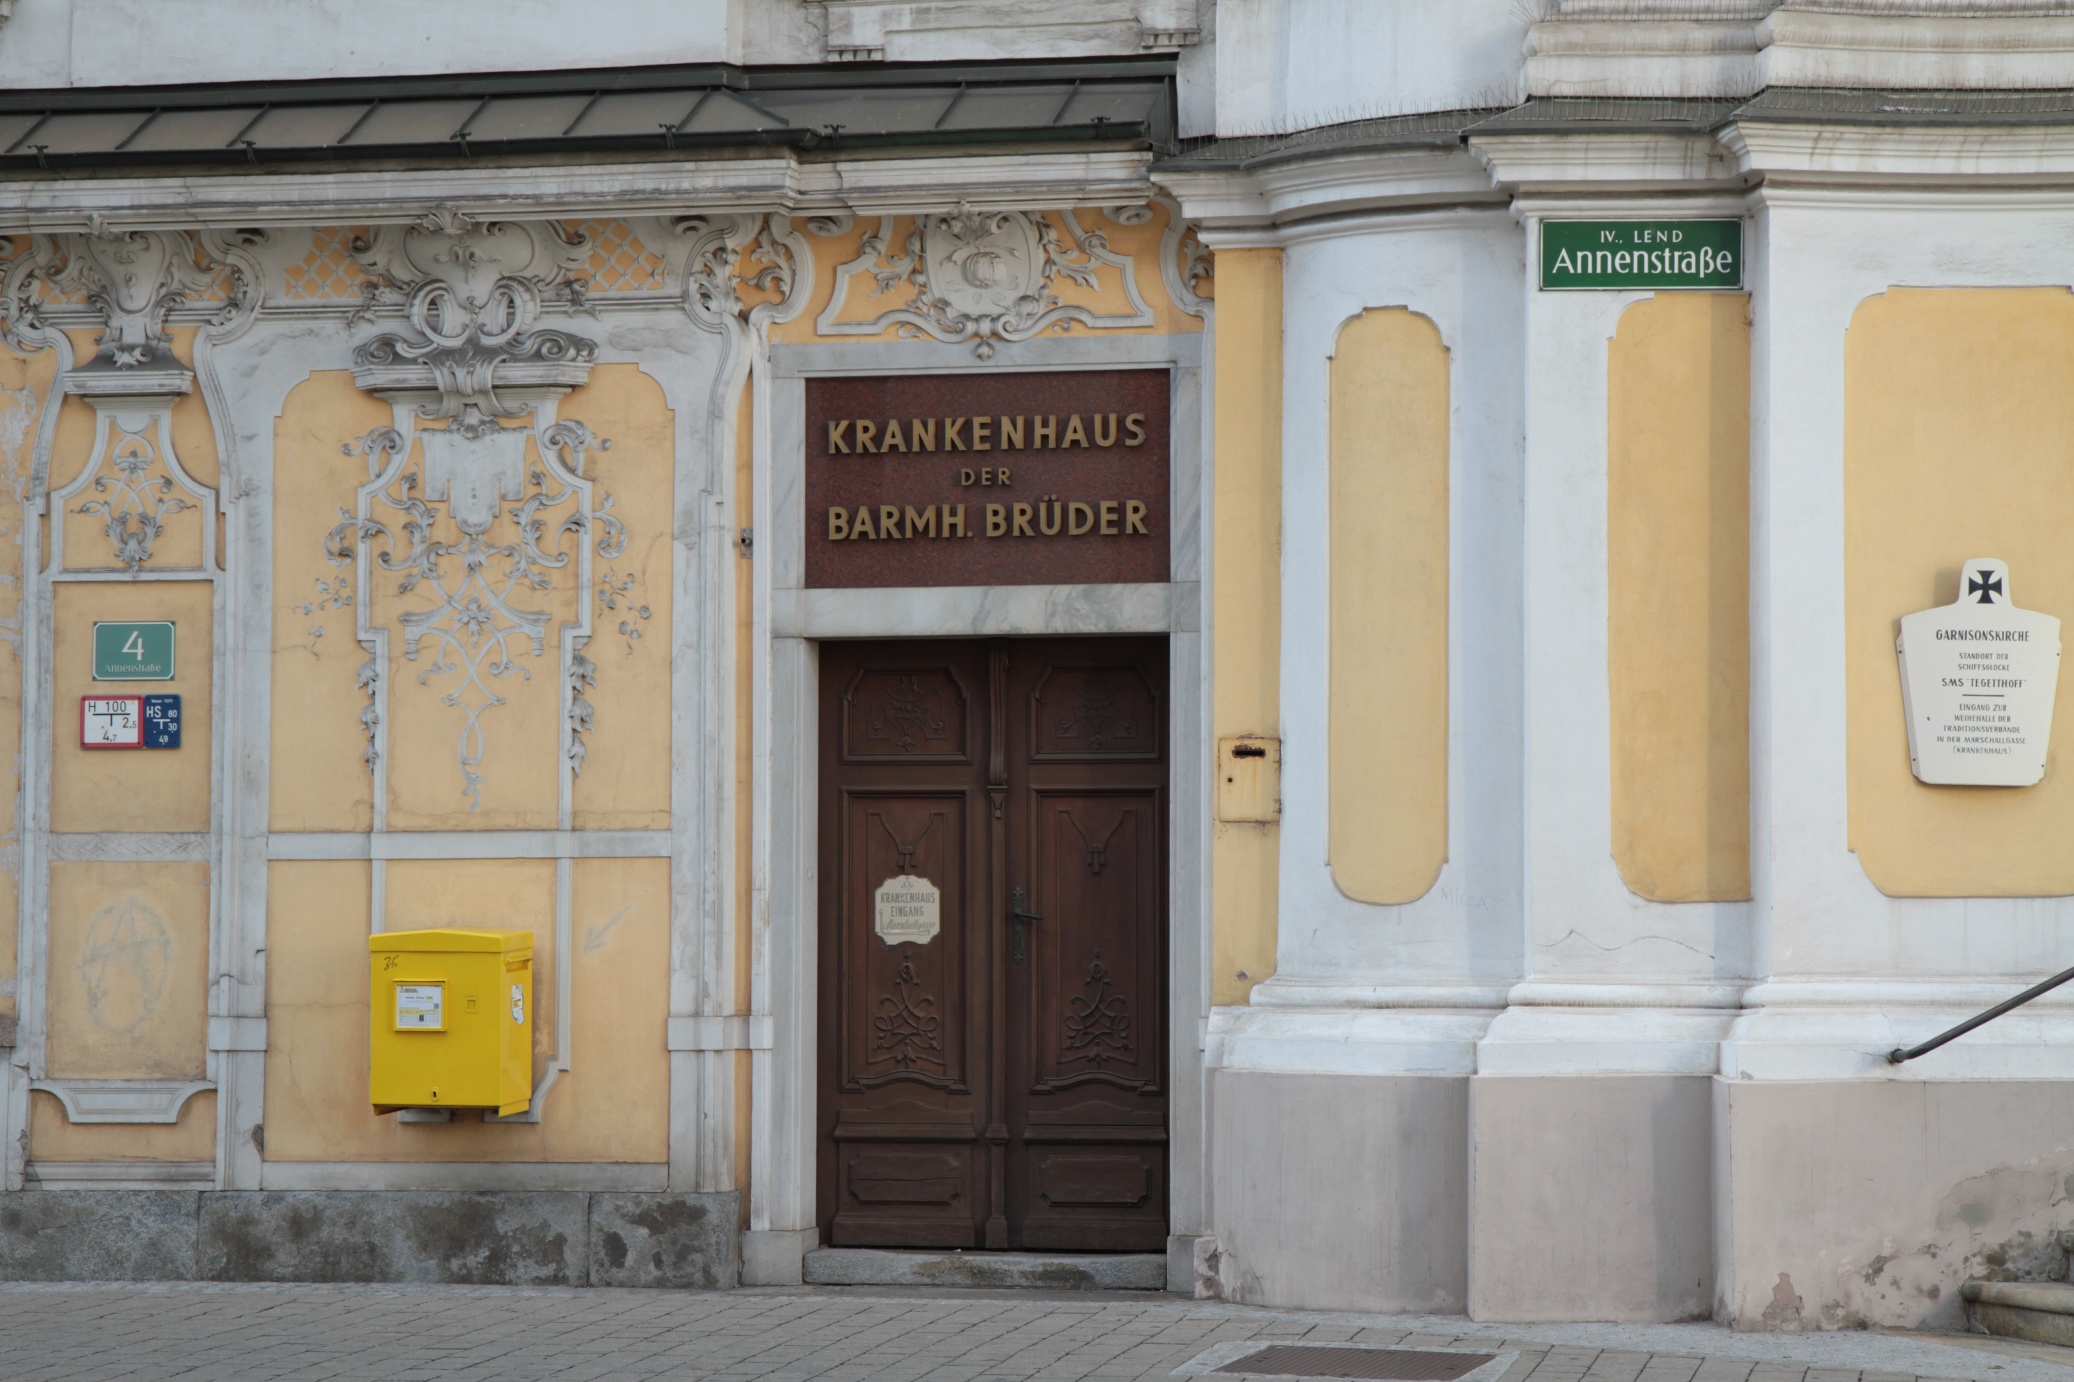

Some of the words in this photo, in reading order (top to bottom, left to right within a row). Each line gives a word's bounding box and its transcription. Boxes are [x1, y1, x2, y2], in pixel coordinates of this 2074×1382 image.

[1634, 230, 1683, 243] LEND
[1551, 246, 1733, 278] Annenstraße
[828, 413, 1146, 454] KRANKENHAUS
[960, 467, 1012, 486] DER
[828, 503, 974, 540] BARMH.
[986, 494, 1148, 538] BRÜDER
[1936, 629, 2029, 641] GARNISONSKIRCHE
[121, 630, 145, 661] 4
[1959, 652, 1993, 660] STANDORT
[104, 663, 161, 673] Annenstraße
[1957, 663, 2011, 671] SCHIFFSGLOCKE
[1941, 677, 1964, 687] SMS
[88, 701, 96, 712] H
[105, 701, 127, 712] 100
[146, 705, 162, 718] HS
[168, 710, 178, 718] 80
[1959, 703, 1990, 711] EINGANG
[122, 716, 137, 729] 2,5
[1954, 714, 1996, 722] WEIHEHALLE
[1998, 715, 2011, 723] DER
[102, 730, 117, 742] 4,7
[1953, 745, 2012, 756] (KRANKENHAUS)
[880, 892, 936, 904] KRANKENHAUS
[890, 906, 924, 917] EINGANG
